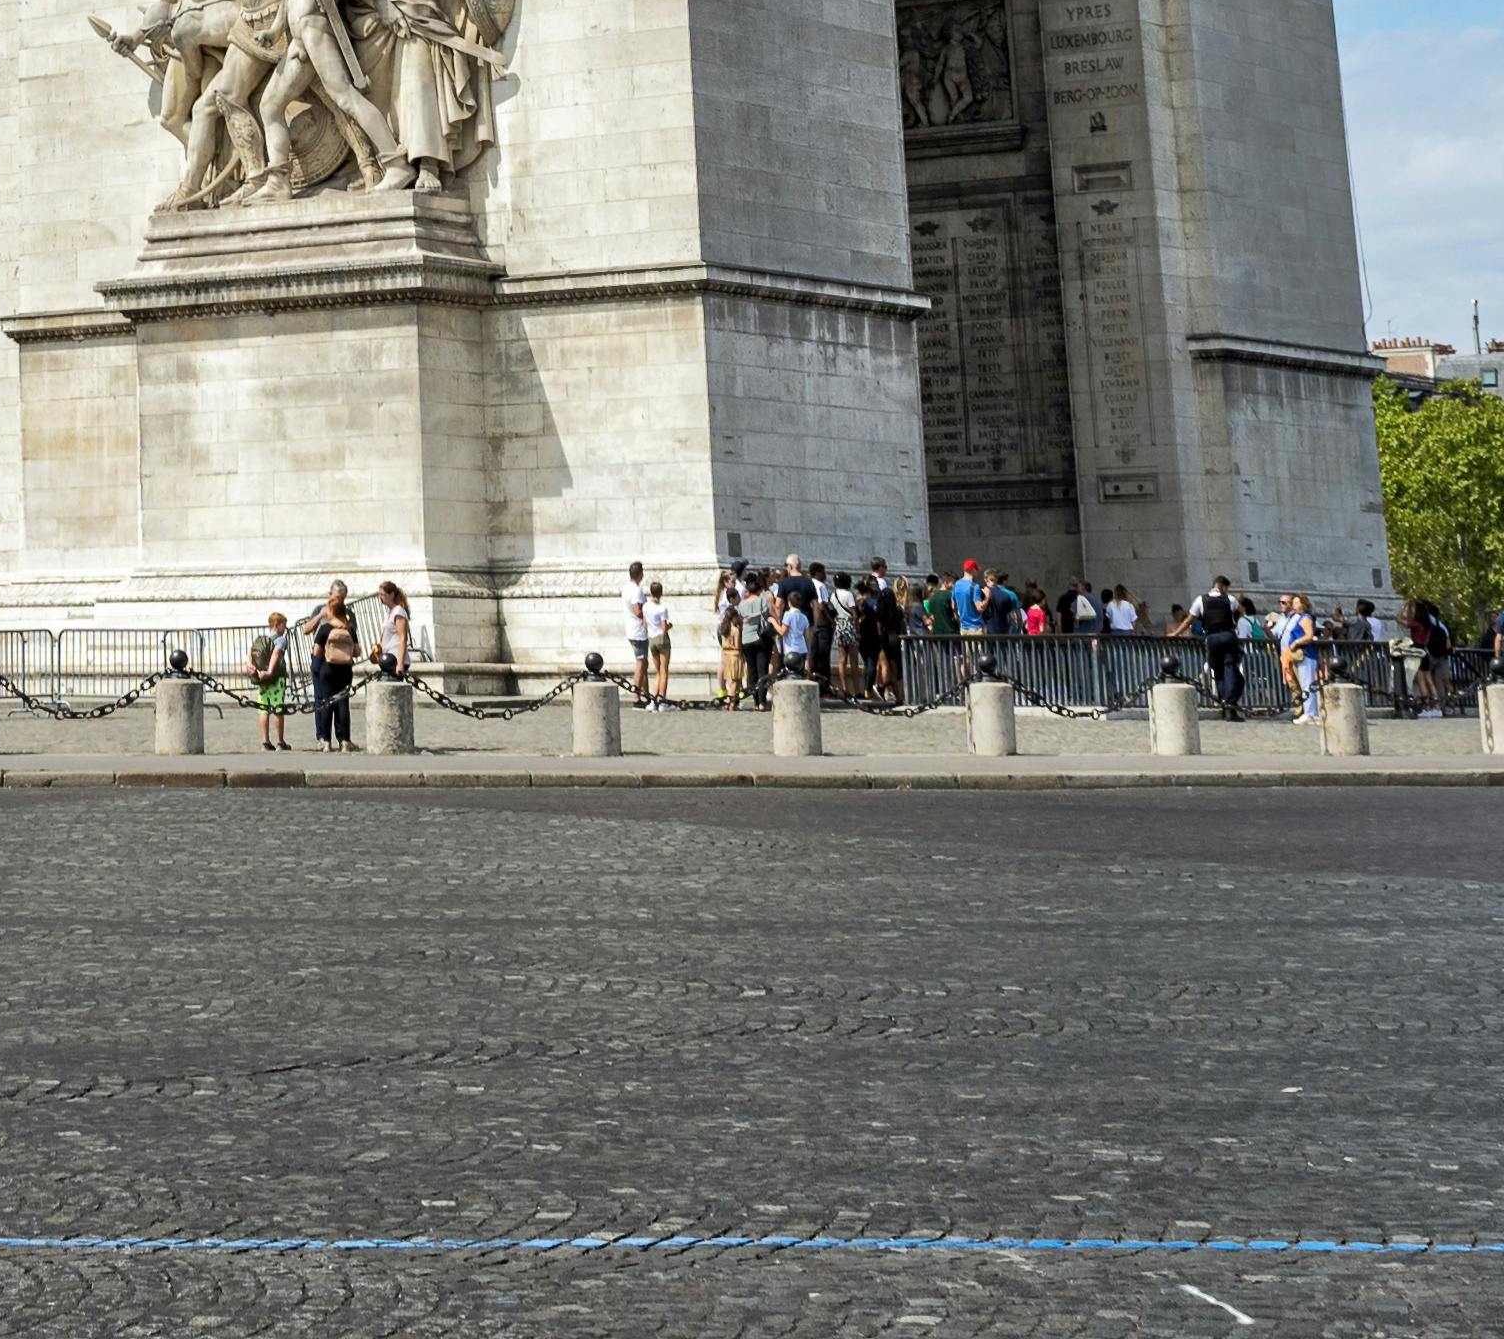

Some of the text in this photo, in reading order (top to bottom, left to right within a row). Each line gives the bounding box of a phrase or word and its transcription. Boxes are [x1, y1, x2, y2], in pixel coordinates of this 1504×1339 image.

[1066, 3, 1112, 21] YPRES
[1050, 28, 1133, 50] LUXEMBOURG
[1064, 57, 1124, 76] BRESLAW
